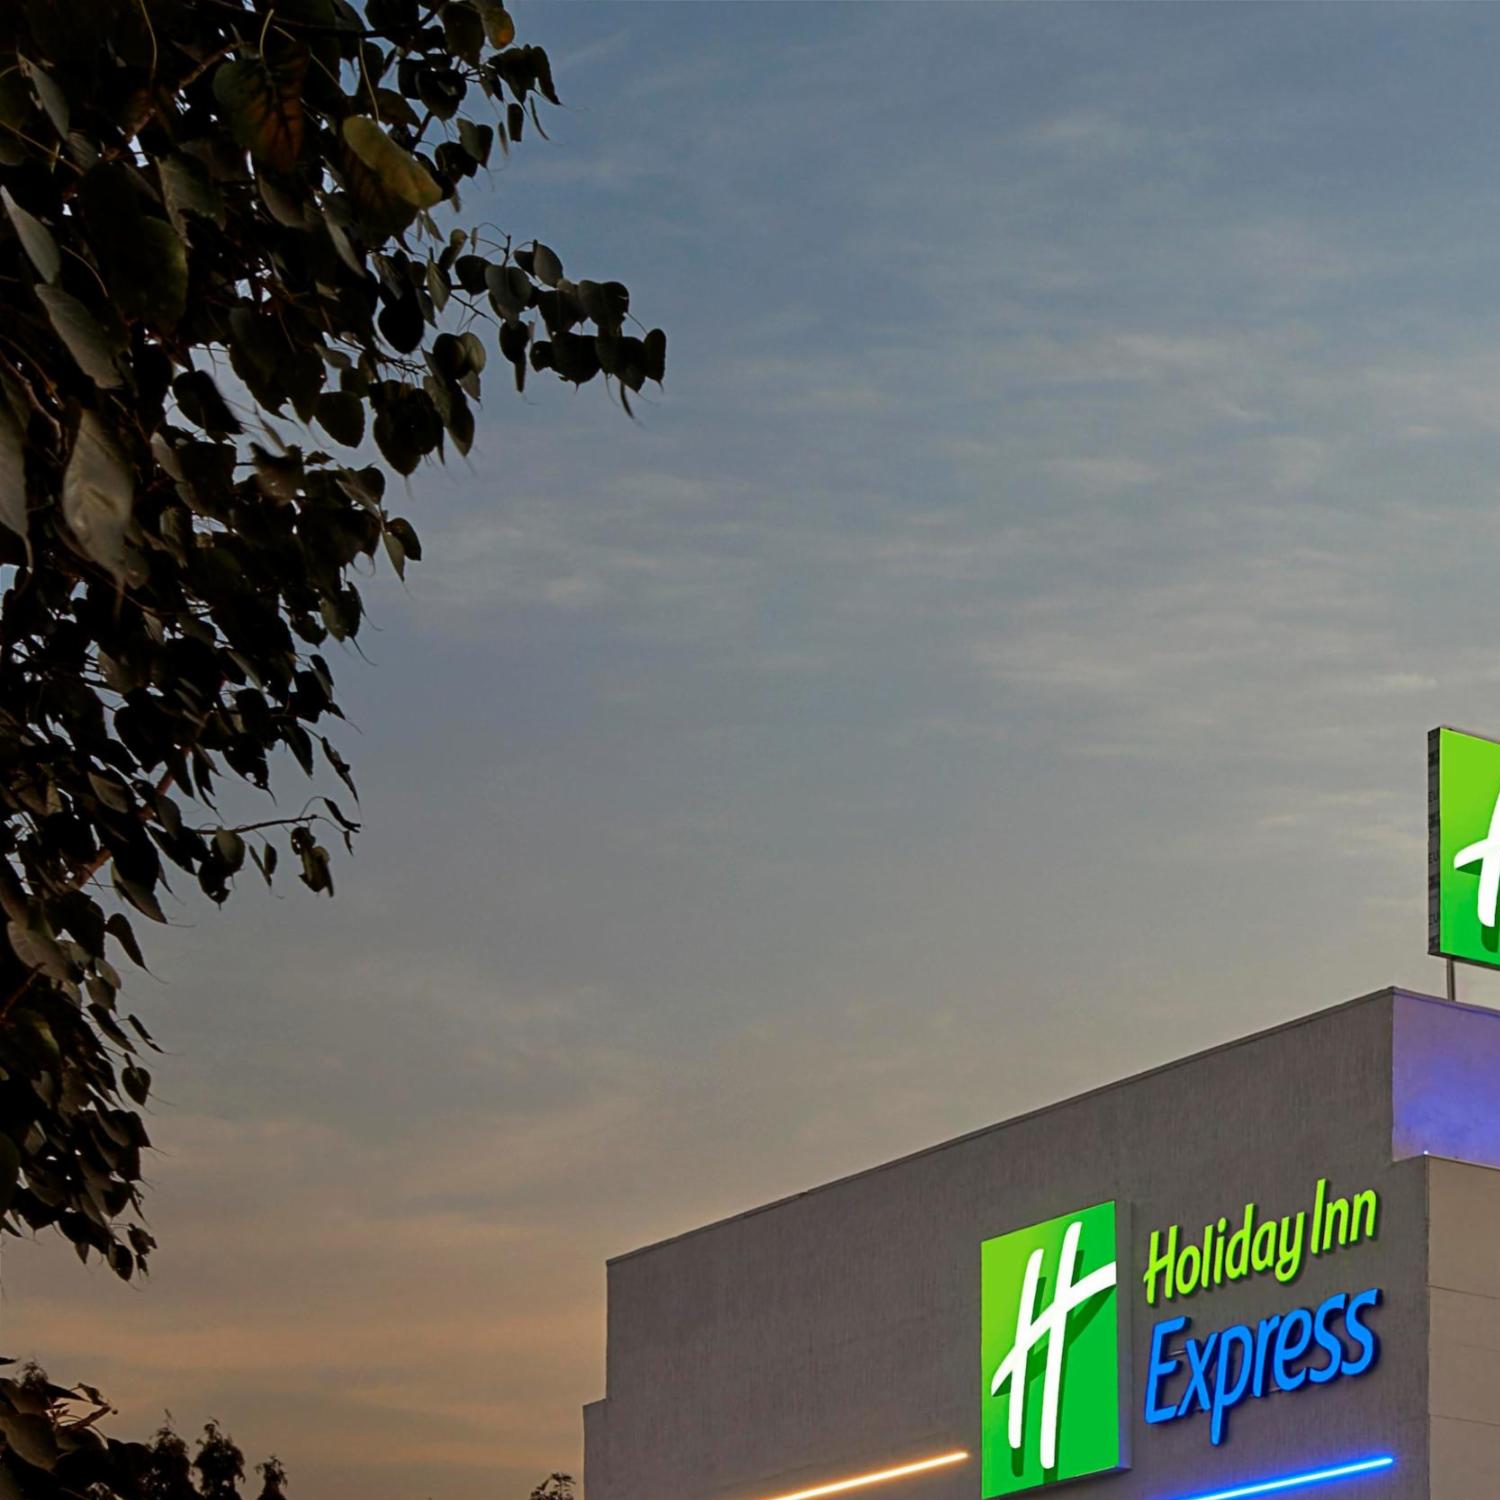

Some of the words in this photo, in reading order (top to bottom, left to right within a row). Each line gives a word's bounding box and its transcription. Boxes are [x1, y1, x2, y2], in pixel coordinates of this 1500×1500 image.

[1143, 1203, 1306, 1304] Holiday
[1310, 1177, 1377, 1255] Inn
[1143, 1287, 1380, 1446] Express
